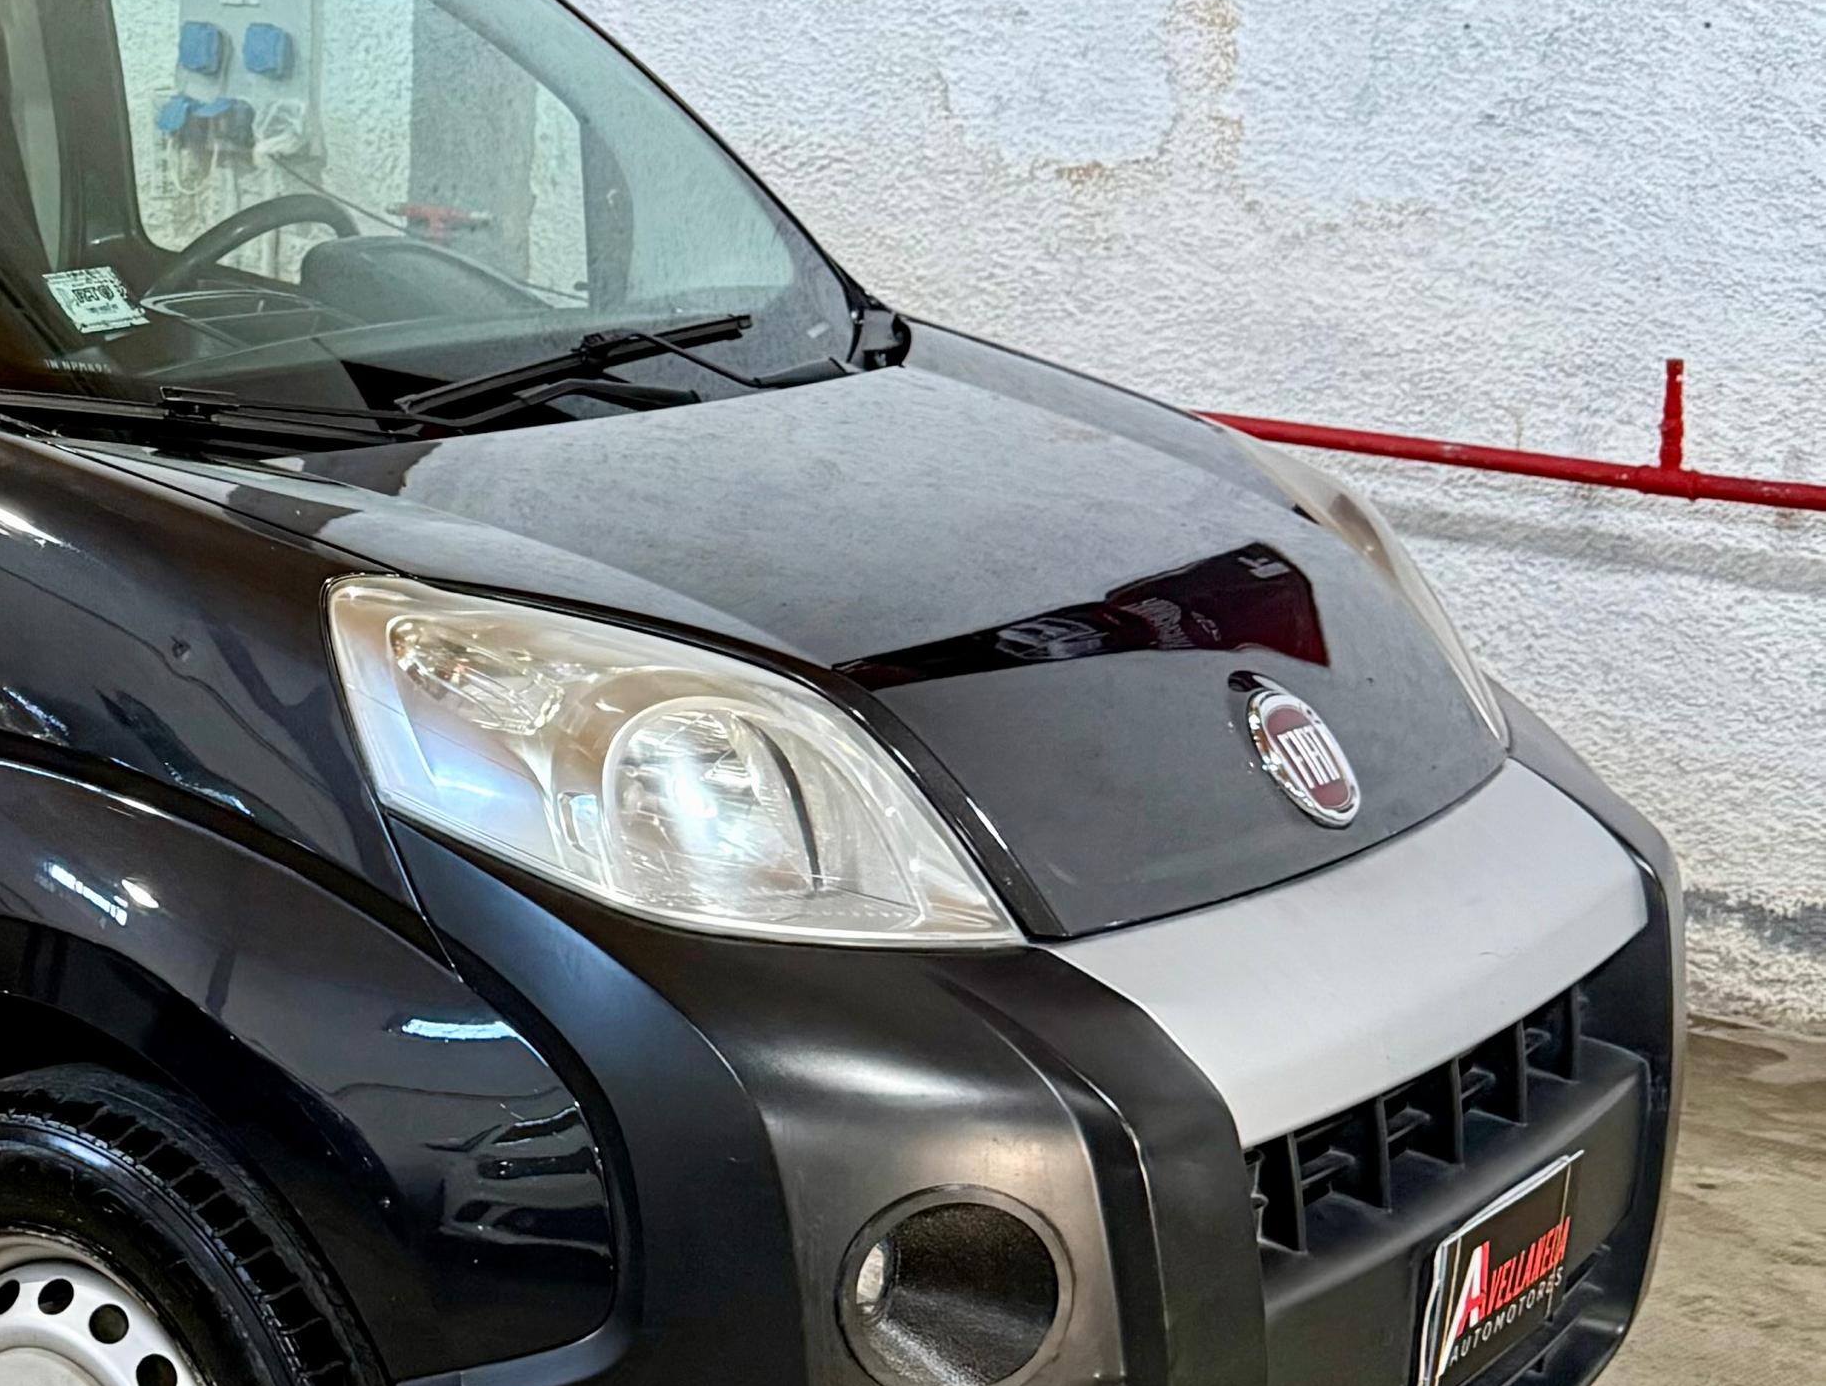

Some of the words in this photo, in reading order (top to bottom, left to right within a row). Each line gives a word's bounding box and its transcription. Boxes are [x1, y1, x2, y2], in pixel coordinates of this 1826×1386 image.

[1277, 724, 1341, 790] FIAT
[1437, 1215, 1571, 1379] AVELLANEDA
[1449, 1265, 1564, 1367] AUTOMOTORES
